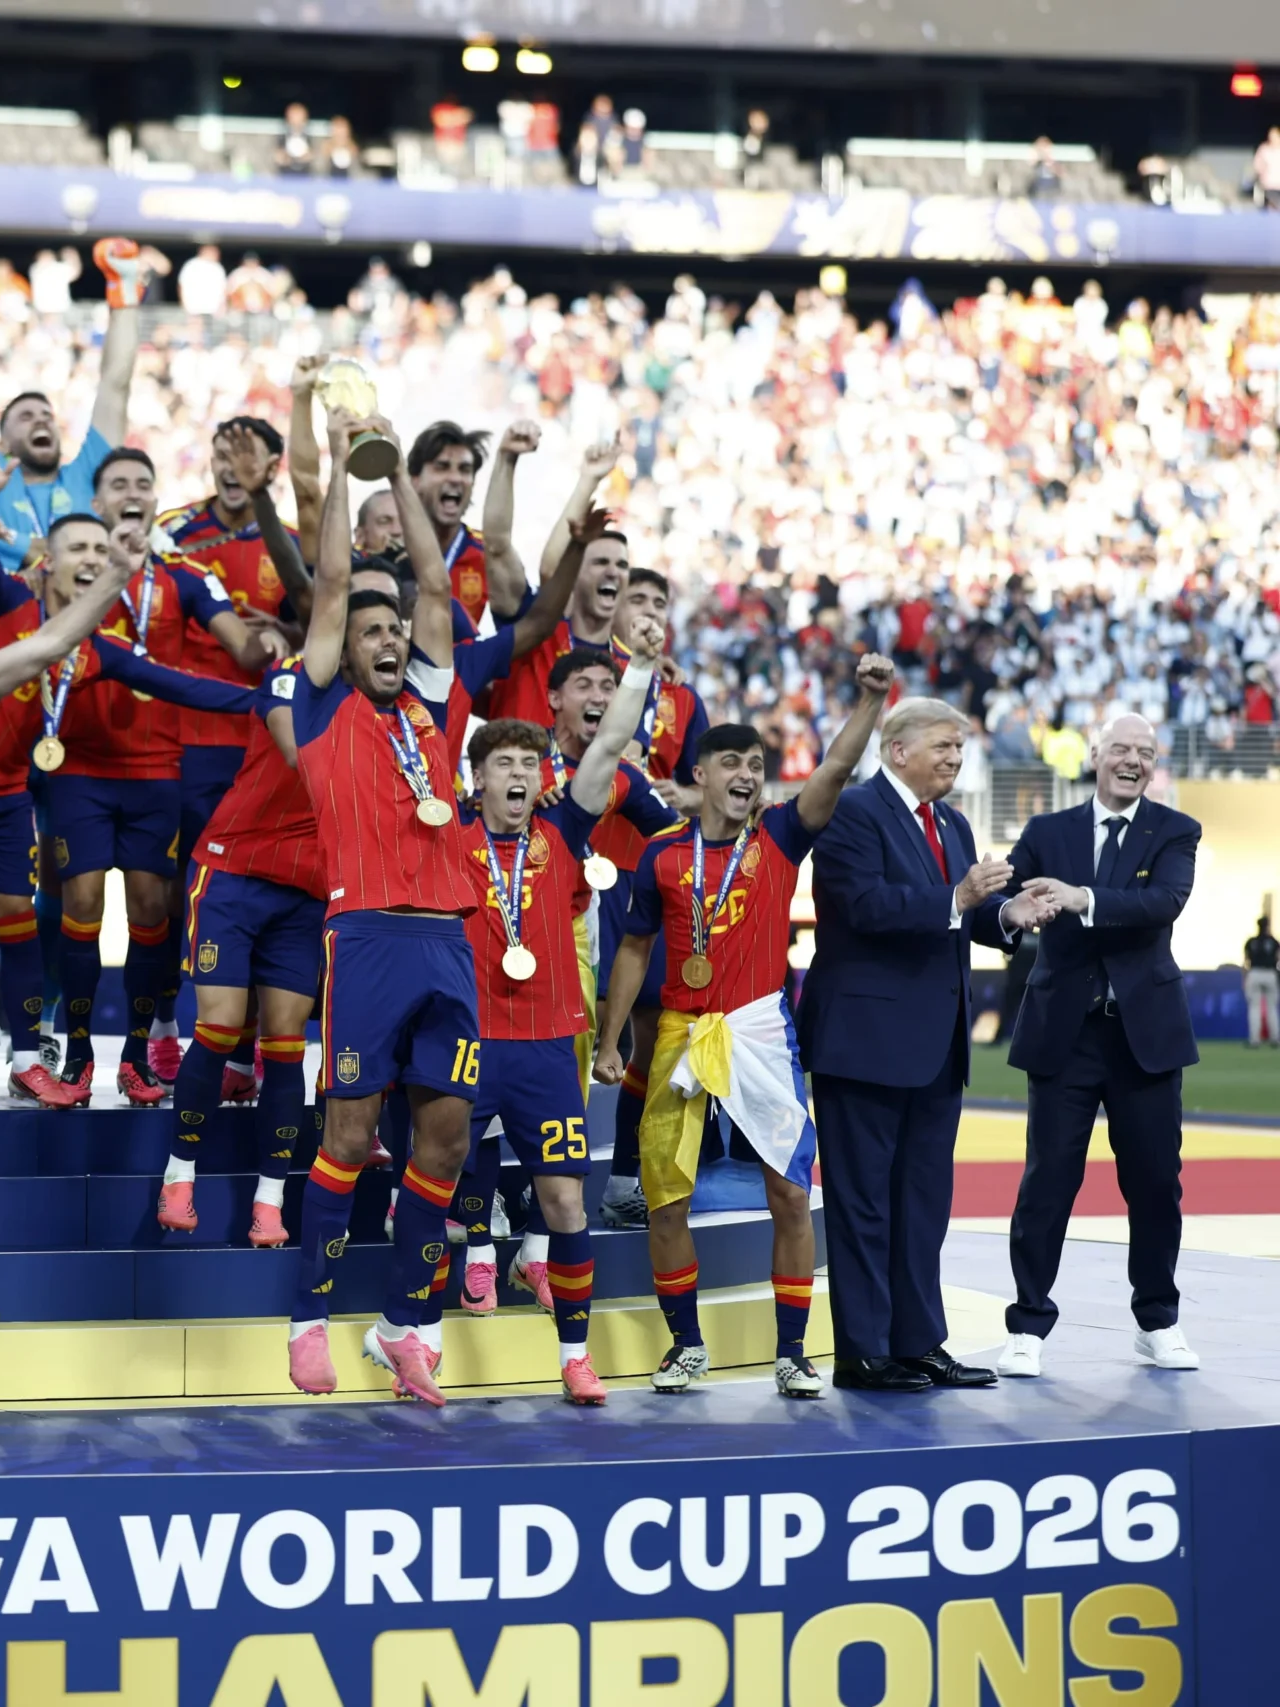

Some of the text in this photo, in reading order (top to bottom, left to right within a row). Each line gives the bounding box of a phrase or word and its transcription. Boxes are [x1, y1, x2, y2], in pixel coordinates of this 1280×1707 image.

[721, 872, 731, 892] WORLD
[450, 1037, 481, 1086] 16
[540, 1117, 587, 1163] 25
[119, 1504, 580, 1611] WORLD
[603, 1492, 826, 1596] CUP
[847, 1468, 1180, 1582] 2026
